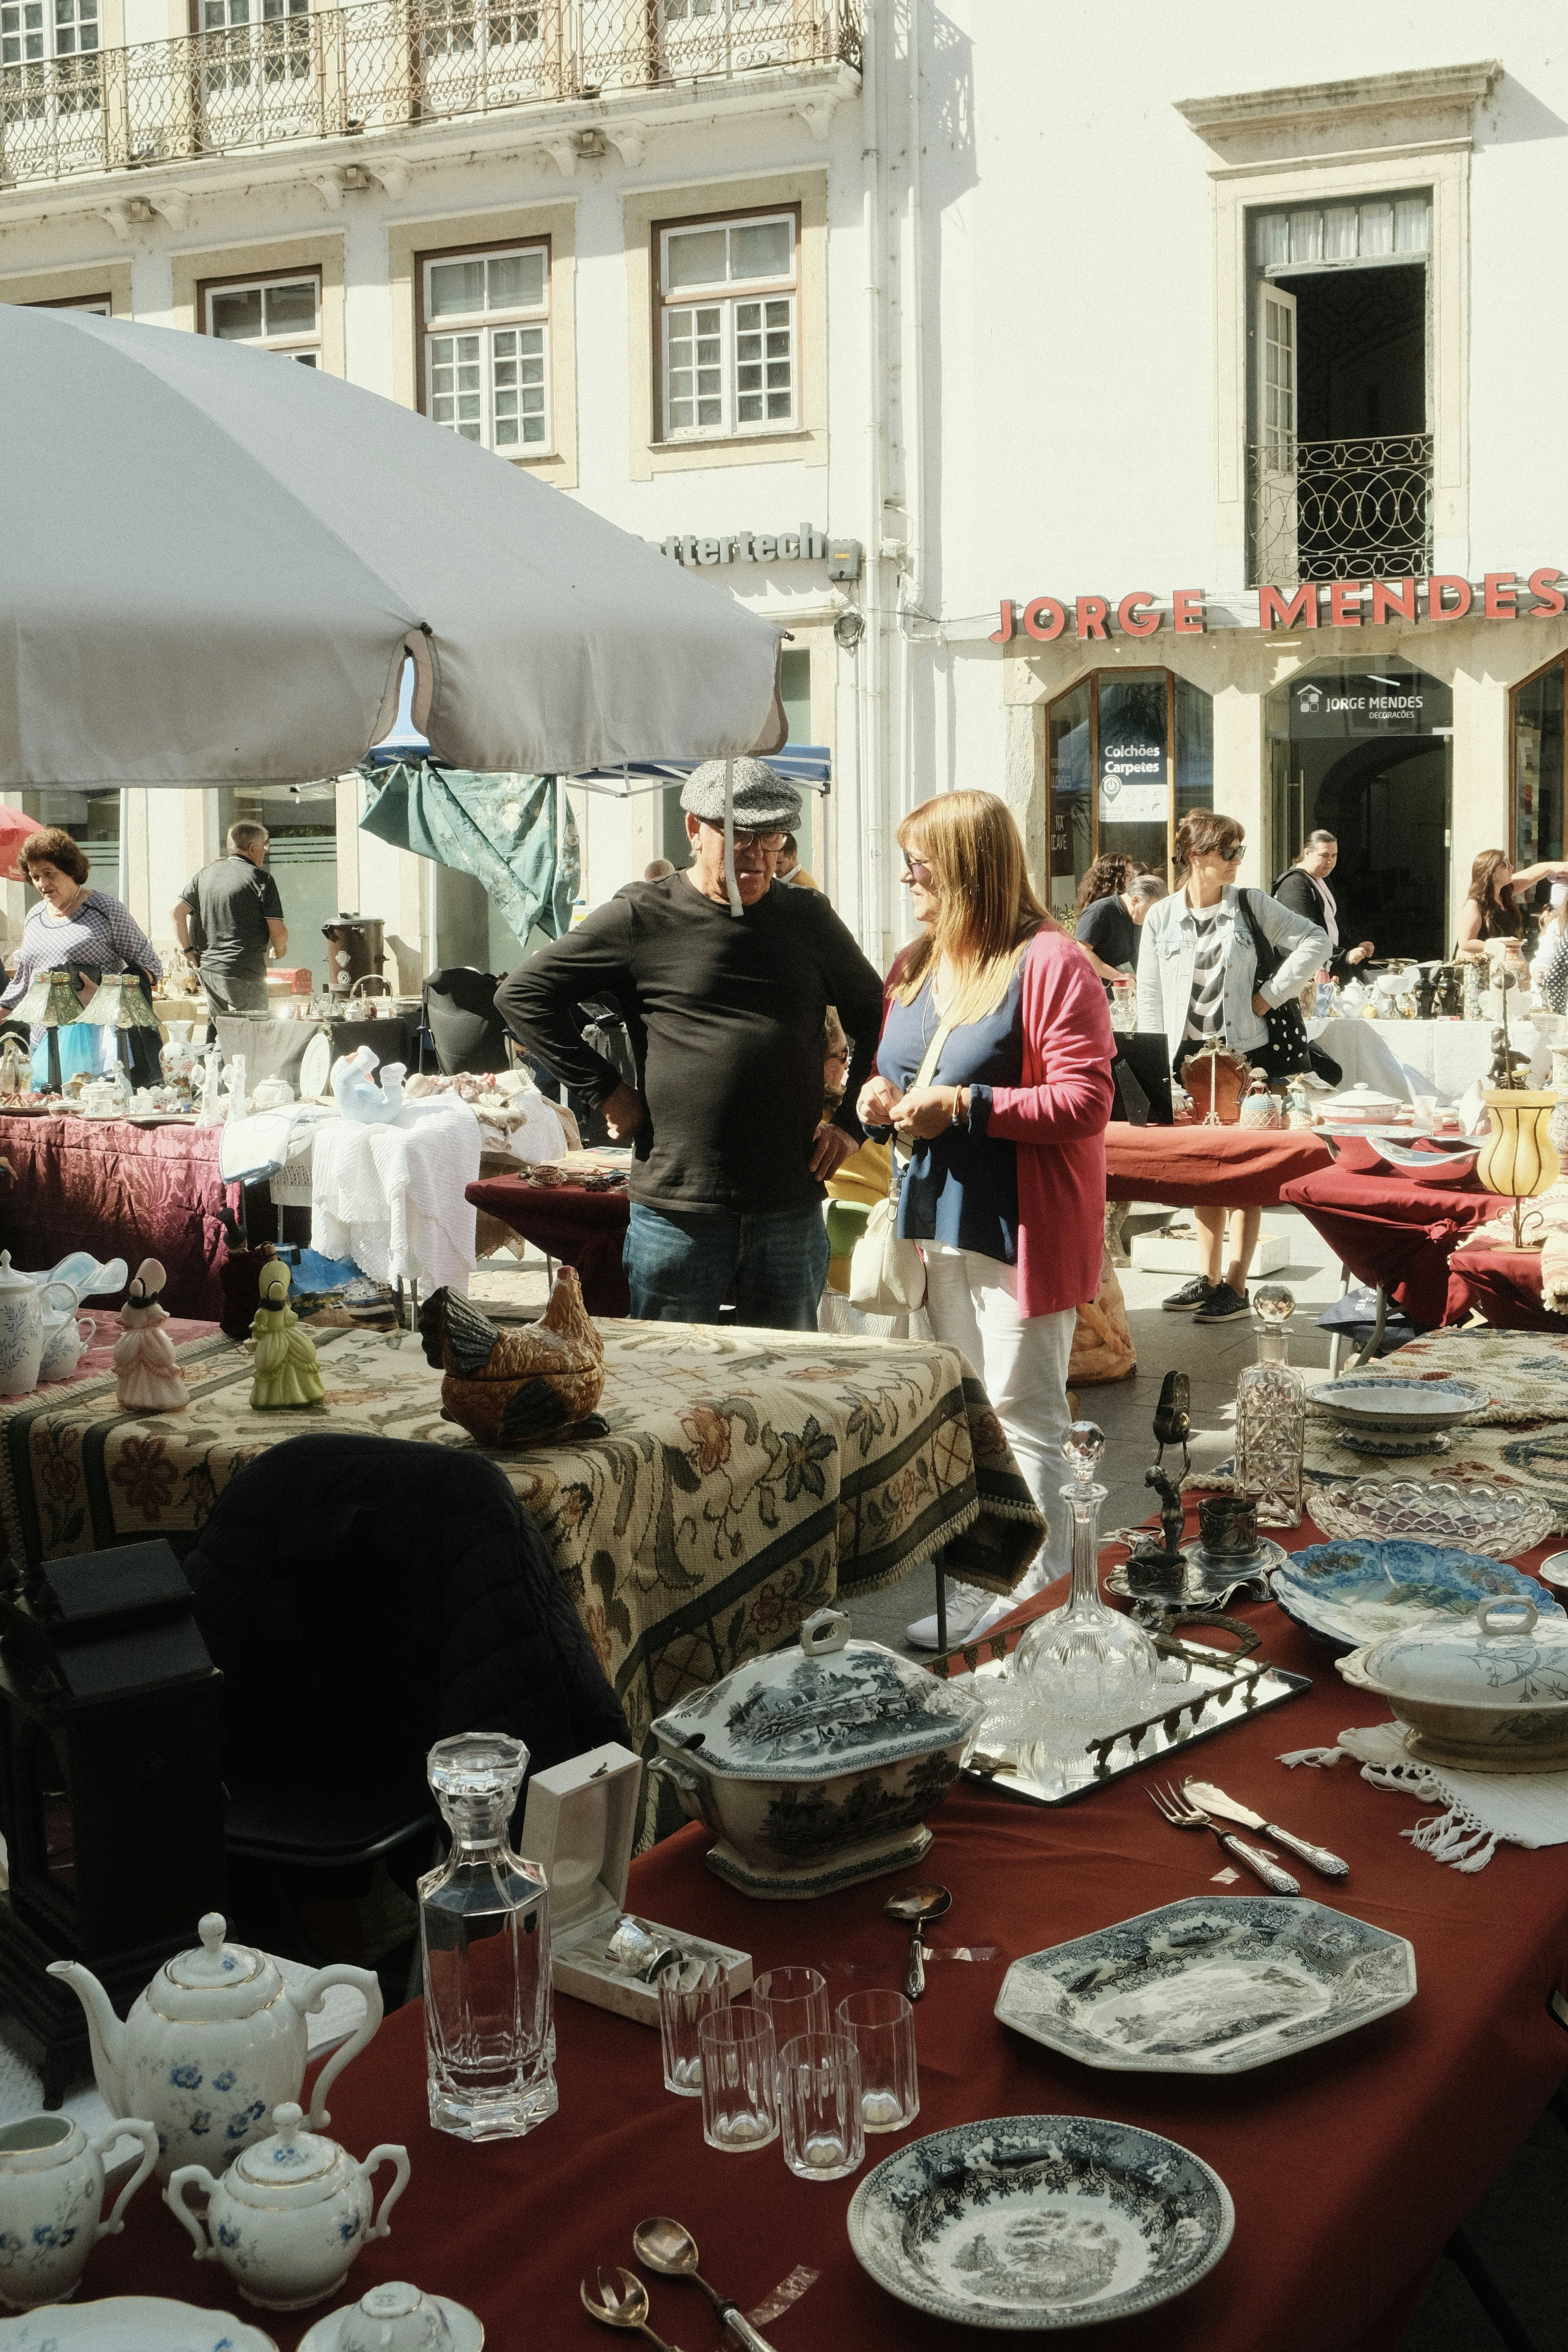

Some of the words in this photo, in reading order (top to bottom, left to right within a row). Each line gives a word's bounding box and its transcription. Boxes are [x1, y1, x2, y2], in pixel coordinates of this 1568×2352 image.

[646, 522, 826, 566] ttertech
[990, 589, 1205, 644] JORGE
[1258, 568, 1566, 631] MENDES
[1326, 697, 1365, 712] JORGE
[1369, 696, 1423, 709] MENDES
[1104, 744, 1160, 757] Colchões
[1104, 761, 1159, 776] Carpetes
